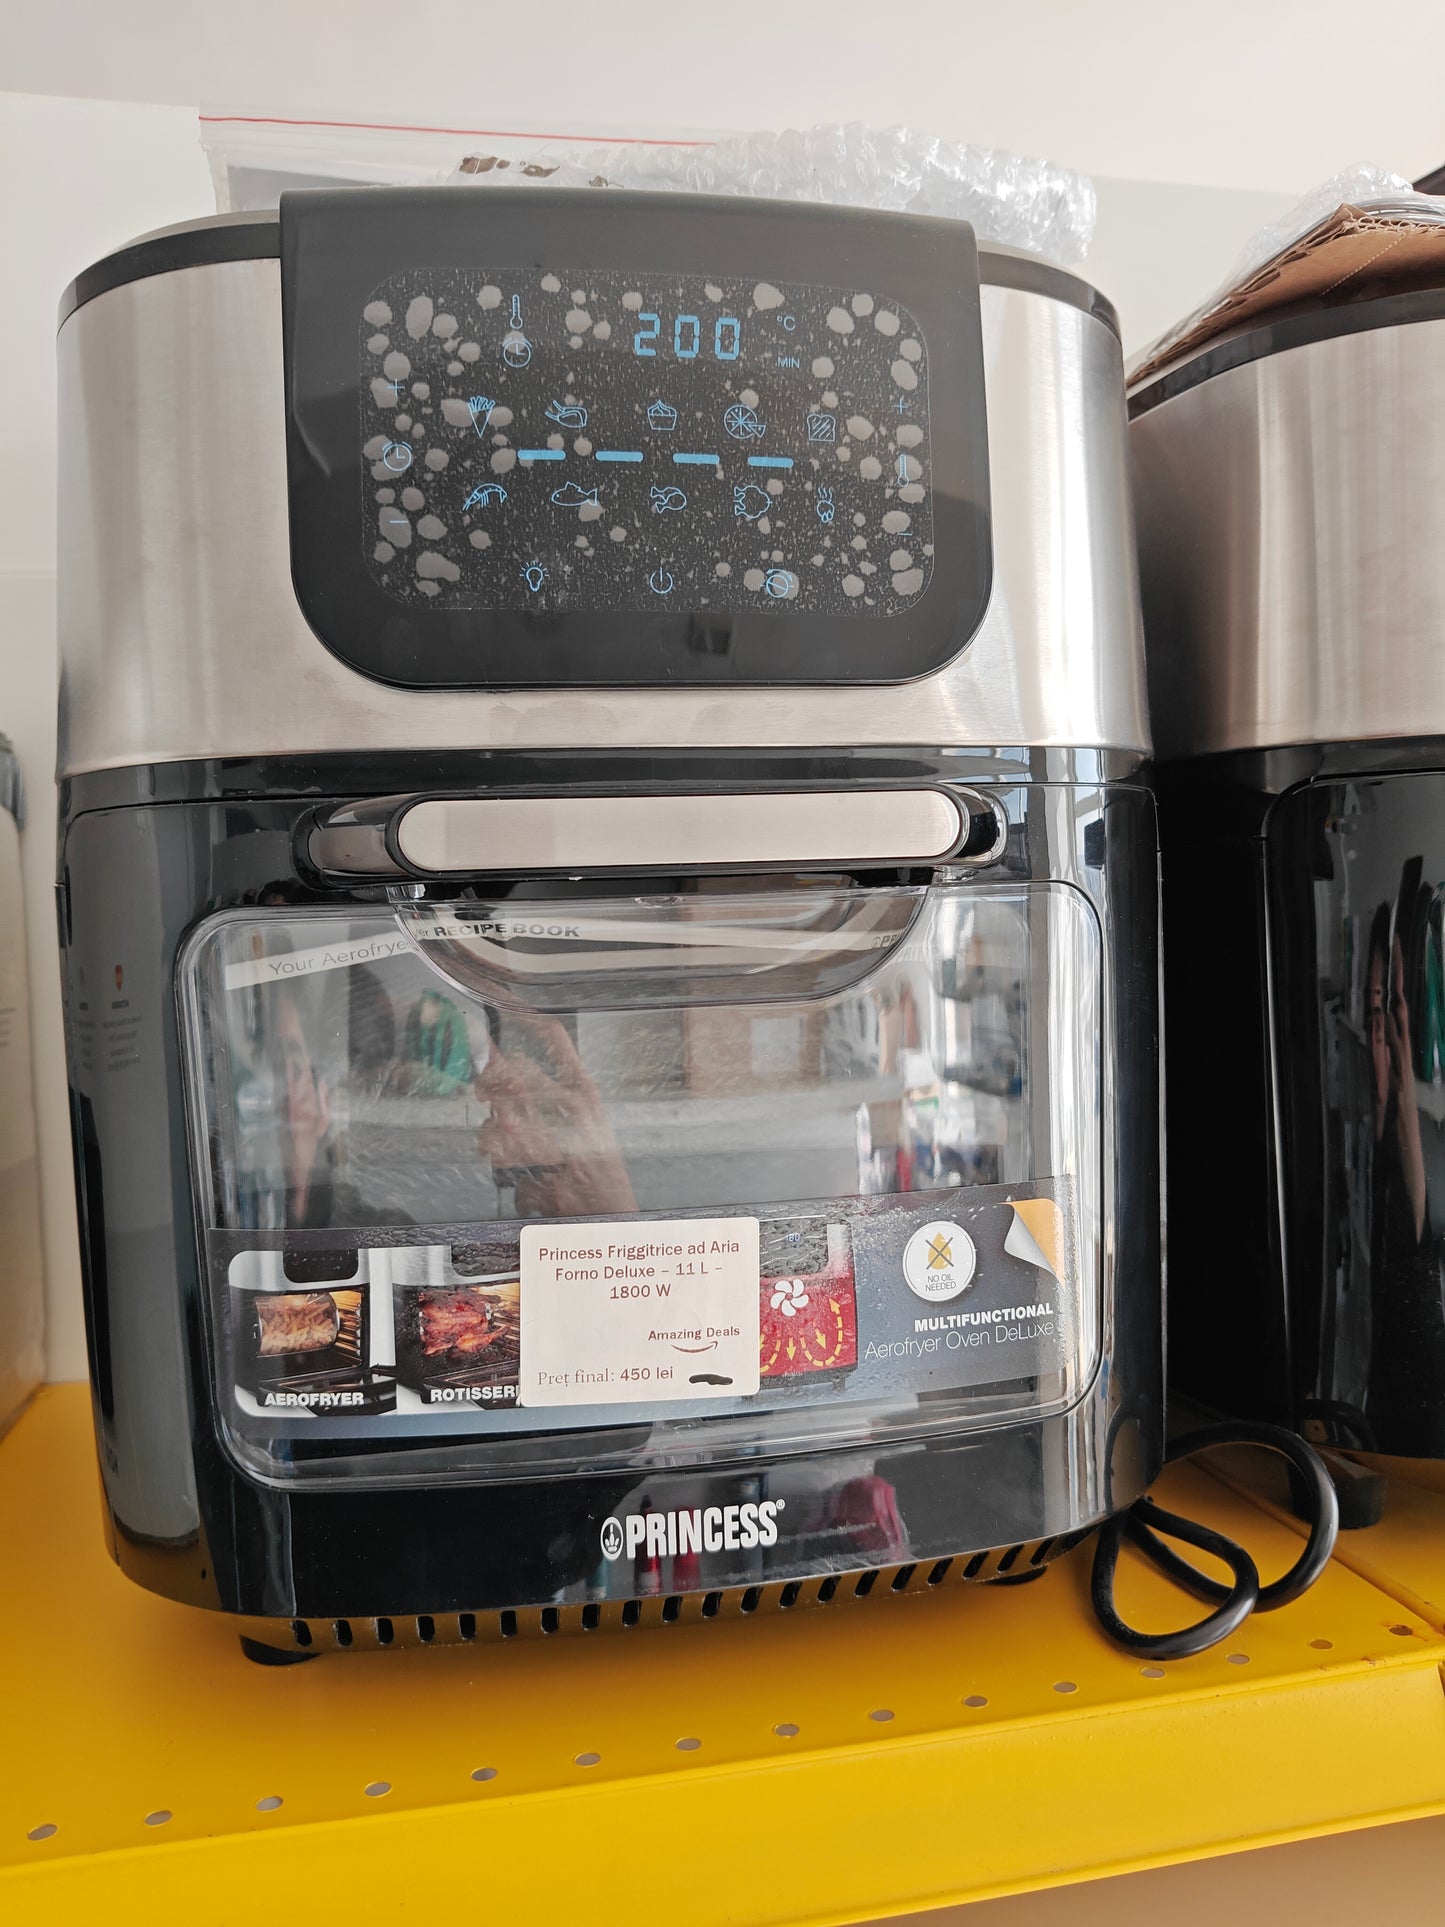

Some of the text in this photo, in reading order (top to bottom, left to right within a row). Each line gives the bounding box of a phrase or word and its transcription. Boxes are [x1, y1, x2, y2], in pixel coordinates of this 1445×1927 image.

[634, 313, 741, 360] 200
[777, 357, 800, 368] MIN
[269, 958, 315, 976] Your
[434, 923, 507, 937] RECIPE
[513, 923, 580, 938] BOOK
[539, 1240, 740, 1261] Princess Friggitrice ad Aria
[555, 1267, 599, 1281] Forno
[604, 1265, 655, 1279] Deluxe
[675, 1263, 695, 1276] 11
[700, 1262, 709, 1275] L
[927, 1273, 954, 1283] NO OIL
[610, 1284, 672, 1299] 1800 W
[925, 1281, 957, 1291] NEEDED
[914, 1303, 1054, 1333] MULTIFUNCTIONAL
[648, 1326, 740, 1341] Amazing Deals
[864, 1320, 1054, 1360] Aerofryer Oven DeLuxe
[574, 1368, 615, 1383] final:
[619, 1368, 651, 1381] 450
[656, 1366, 674, 1379] lei
[264, 1392, 365, 1407] AEROFRYER
